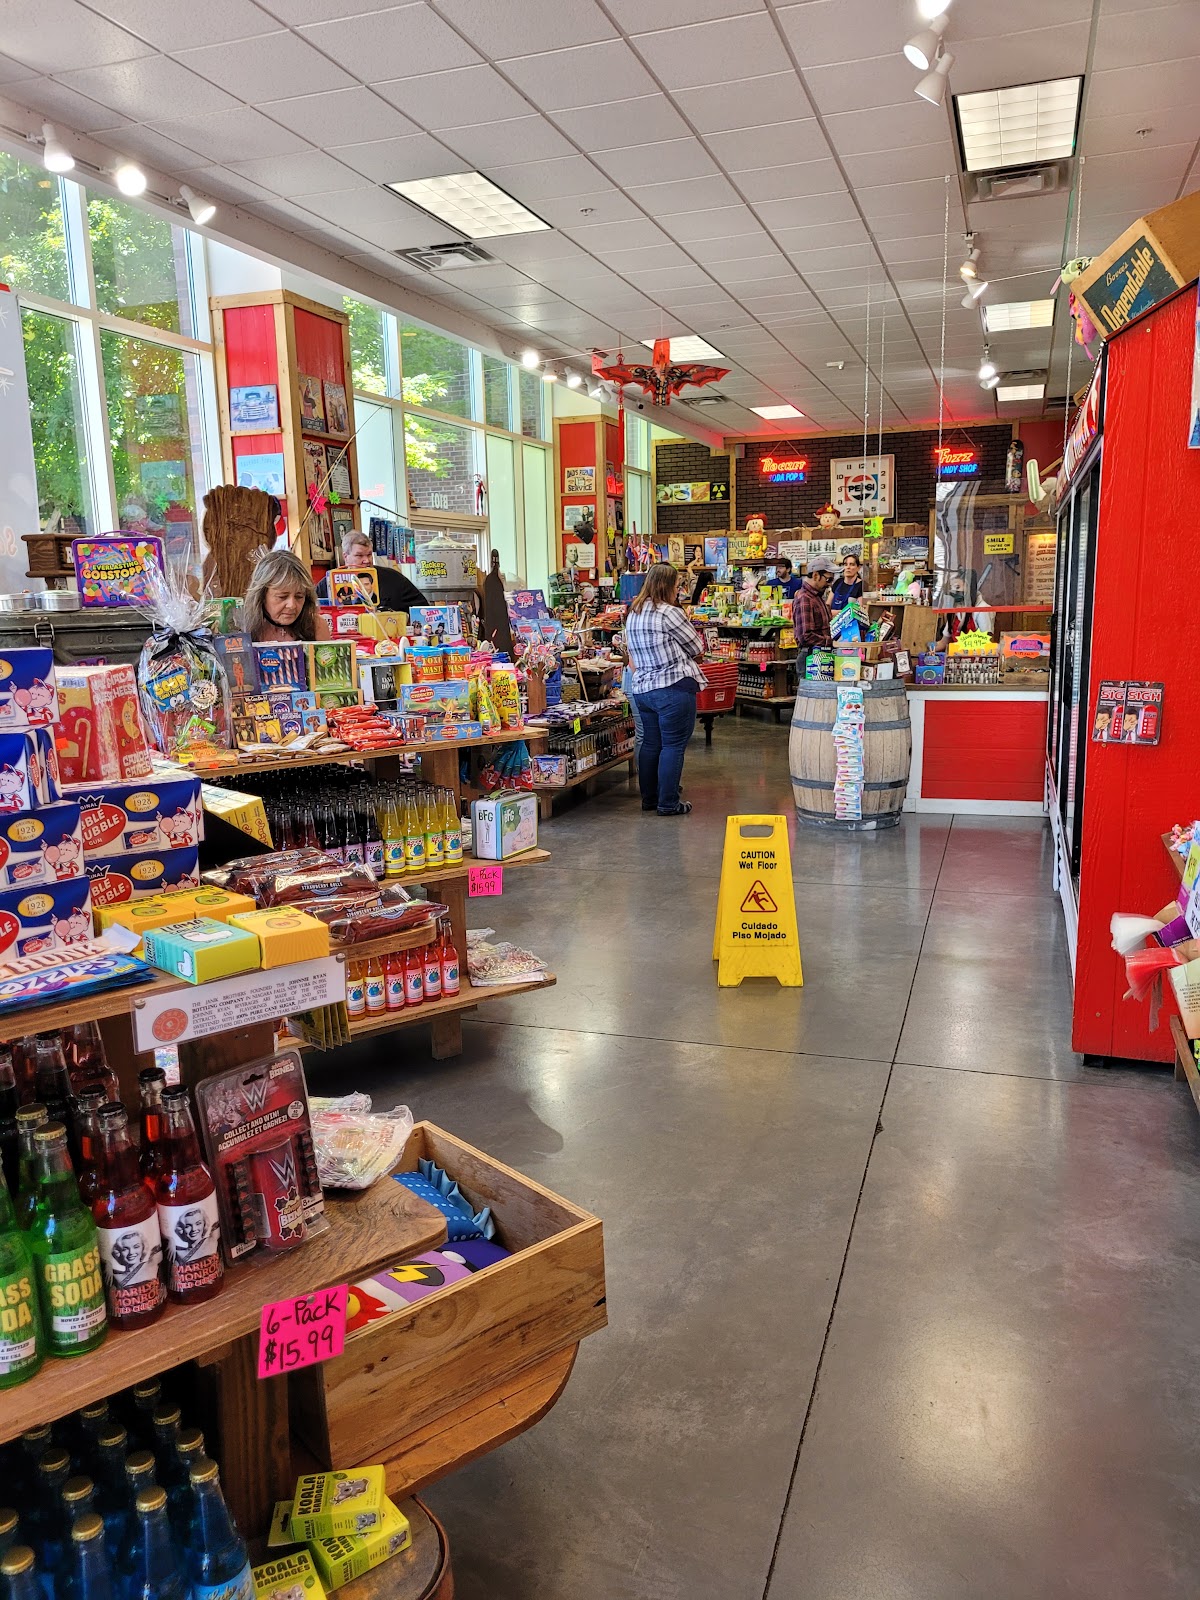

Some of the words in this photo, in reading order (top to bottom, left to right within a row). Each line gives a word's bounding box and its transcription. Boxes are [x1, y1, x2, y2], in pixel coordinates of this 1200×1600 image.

[1101, 247, 1154, 331] Dependable
[959, 463, 978, 473] SHOP
[92, 560, 139, 570] EVERLASTING
[224, 638, 243, 647] CAT
[153, 676, 187, 697] SOUR
[1128, 691, 1161, 702] SIGH
[15, 820, 35, 829] ORIGINAL
[478, 810, 494, 822] BFG
[504, 809, 515, 823] BFG
[89, 838, 103, 846] GUM
[138, 860, 157, 868] ORIGINAL
[741, 851, 775, 859] CAUTION
[739, 861, 754, 869] Wet
[757, 861, 777, 869] Floor
[470, 868, 500, 882] 6-Pack
[741, 922, 778, 930] Cuidado
[732, 931, 752, 939] Piso
[754, 931, 787, 941] Mojado
[8, 942, 104, 975] HUNK
[223, 991, 246, 1000] BROTHERS
[250, 985, 272, 994] FOUNDED
[289, 977, 309, 986] JOHNNIE
[192, 1004, 218, 1013] BOTTLING
[219, 997, 244, 1007] COMPANY
[192, 1010, 213, 1019] JOHNNIE
[235, 1000, 259, 1009] BEVERAGES
[192, 1015, 216, 1025] EXTRACTS
[240, 1003, 267, 1013] FLAVORINGS
[273, 996, 295, 1004] AVAILABLE
[193, 1020, 220, 1030] SWEETENED
[298, 998, 307, 1006] JUST
[209, 1021, 232, 1031] BROTHERS
[257, 1011, 276, 1019] SEVENTY
[218, 1129, 255, 1151] ACCUMULEZ
[254, 1125, 263, 1135] ET
[262, 1115, 288, 1130] GAGNEZ!
[223, 1122, 250, 1140] COLLECT
[250, 1117, 264, 1131] AND
[263, 1110, 280, 1123] WIN!
[44, 1246, 100, 1283] GRASS
[173, 1253, 219, 1273] MARILYN
[174, 1261, 219, 1282] MONROE
[51, 1268, 102, 1308] SODA
[112, 1279, 159, 1298] MARILYN
[177, 1281, 193, 1289] WILD
[194, 1272, 219, 1287] CHERRY
[112, 1287, 159, 1307] MONROE
[115, 1306, 131, 1314] WILD
[132, 1298, 159, 1312] CHERRY
[85, 1308, 103, 1319] BOTTLED
[266, 1290, 341, 1335] 6-Pack
[6, 1342, 30, 1352] BOTTLED
[264, 1325, 333, 1370] $15.99
[298, 1476, 316, 1515] KOALA
[312, 1475, 326, 1513] BANDAGES
[253, 1554, 309, 1581] KOALA
[257, 1565, 311, 1589] BANDAGES
[342, 1562, 351, 1582] KOALA
